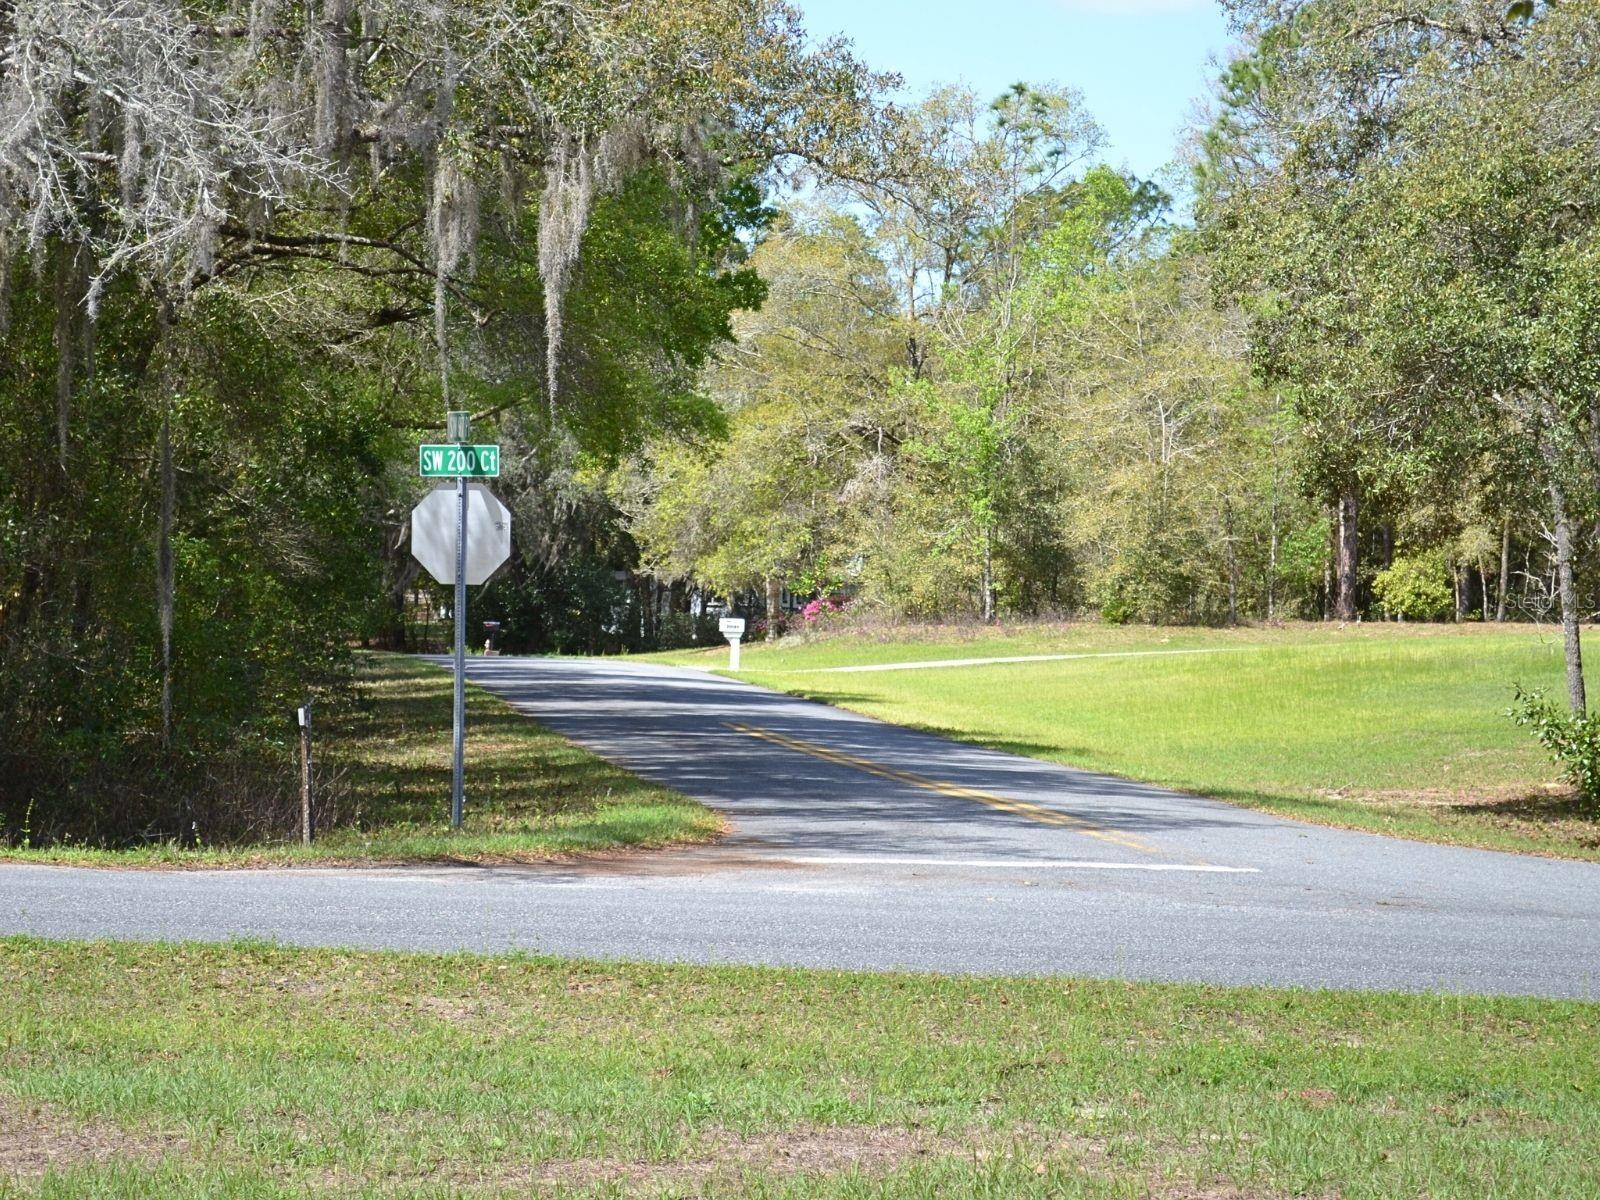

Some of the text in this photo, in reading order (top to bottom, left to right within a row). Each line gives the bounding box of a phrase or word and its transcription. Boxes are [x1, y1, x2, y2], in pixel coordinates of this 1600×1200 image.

[423, 450, 496, 472] SW 200 Ct
